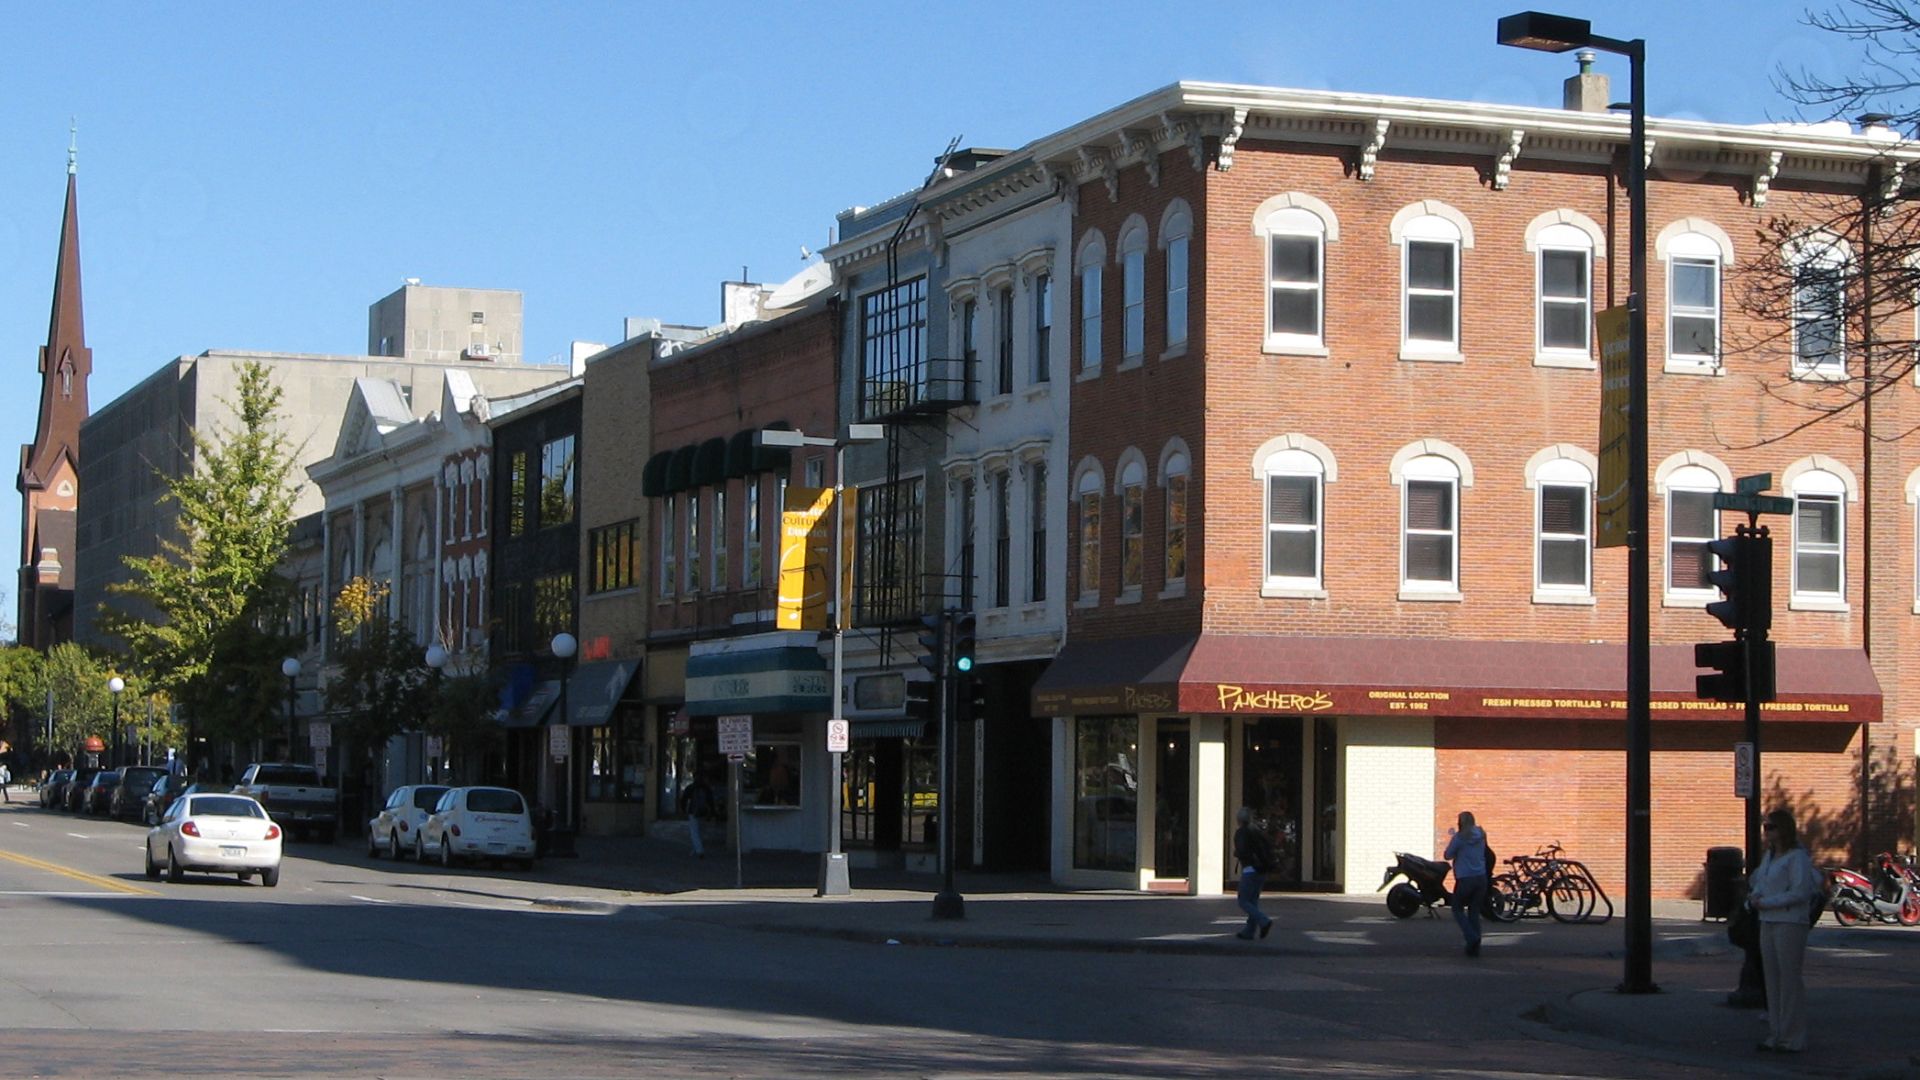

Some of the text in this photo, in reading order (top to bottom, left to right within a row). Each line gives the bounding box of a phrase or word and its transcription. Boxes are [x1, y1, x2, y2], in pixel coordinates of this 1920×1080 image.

[1368, 691, 1450, 700] ORIGINAL LOCATION
[1389, 702, 1408, 710] EST.
[1482, 698, 1511, 707] FRESH
[1513, 699, 1552, 708] PRESSED
[1554, 700, 1602, 708] TORTILLAS
[1610, 701, 1628, 709] FRE
[1649, 701, 1680, 710] ESSED
[1681, 702, 1727, 710] TORTILLAS
[1765, 703, 1803, 712] PRESSED
[1804, 703, 1850, 712] TORTILLAS
